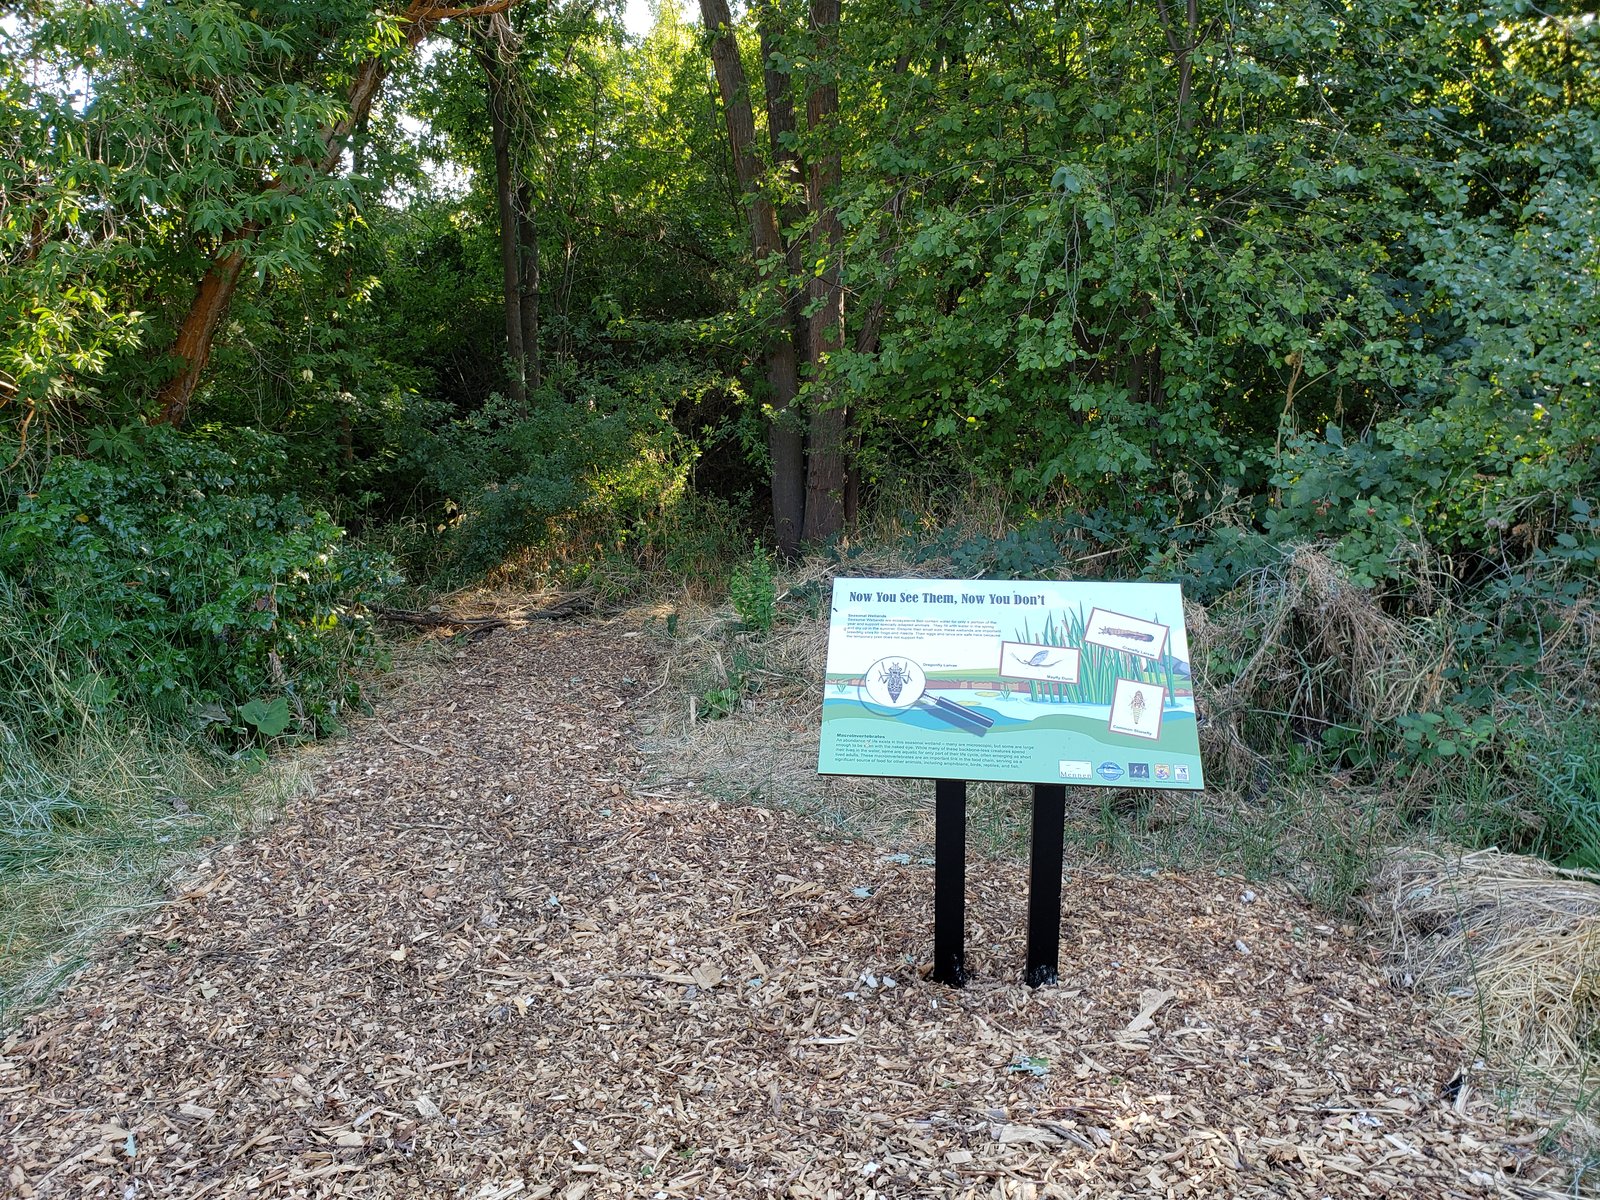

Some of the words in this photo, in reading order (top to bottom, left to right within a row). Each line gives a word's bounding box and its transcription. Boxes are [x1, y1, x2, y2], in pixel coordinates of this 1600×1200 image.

[850, 592, 872, 602] Now
[876, 592, 896, 602] You
[900, 592, 918, 603] See
[922, 593, 957, 605] Them,
[961, 594, 985, 604] Now
[989, 594, 1010, 605] You
[1014, 594, 1044, 605] Don’t
